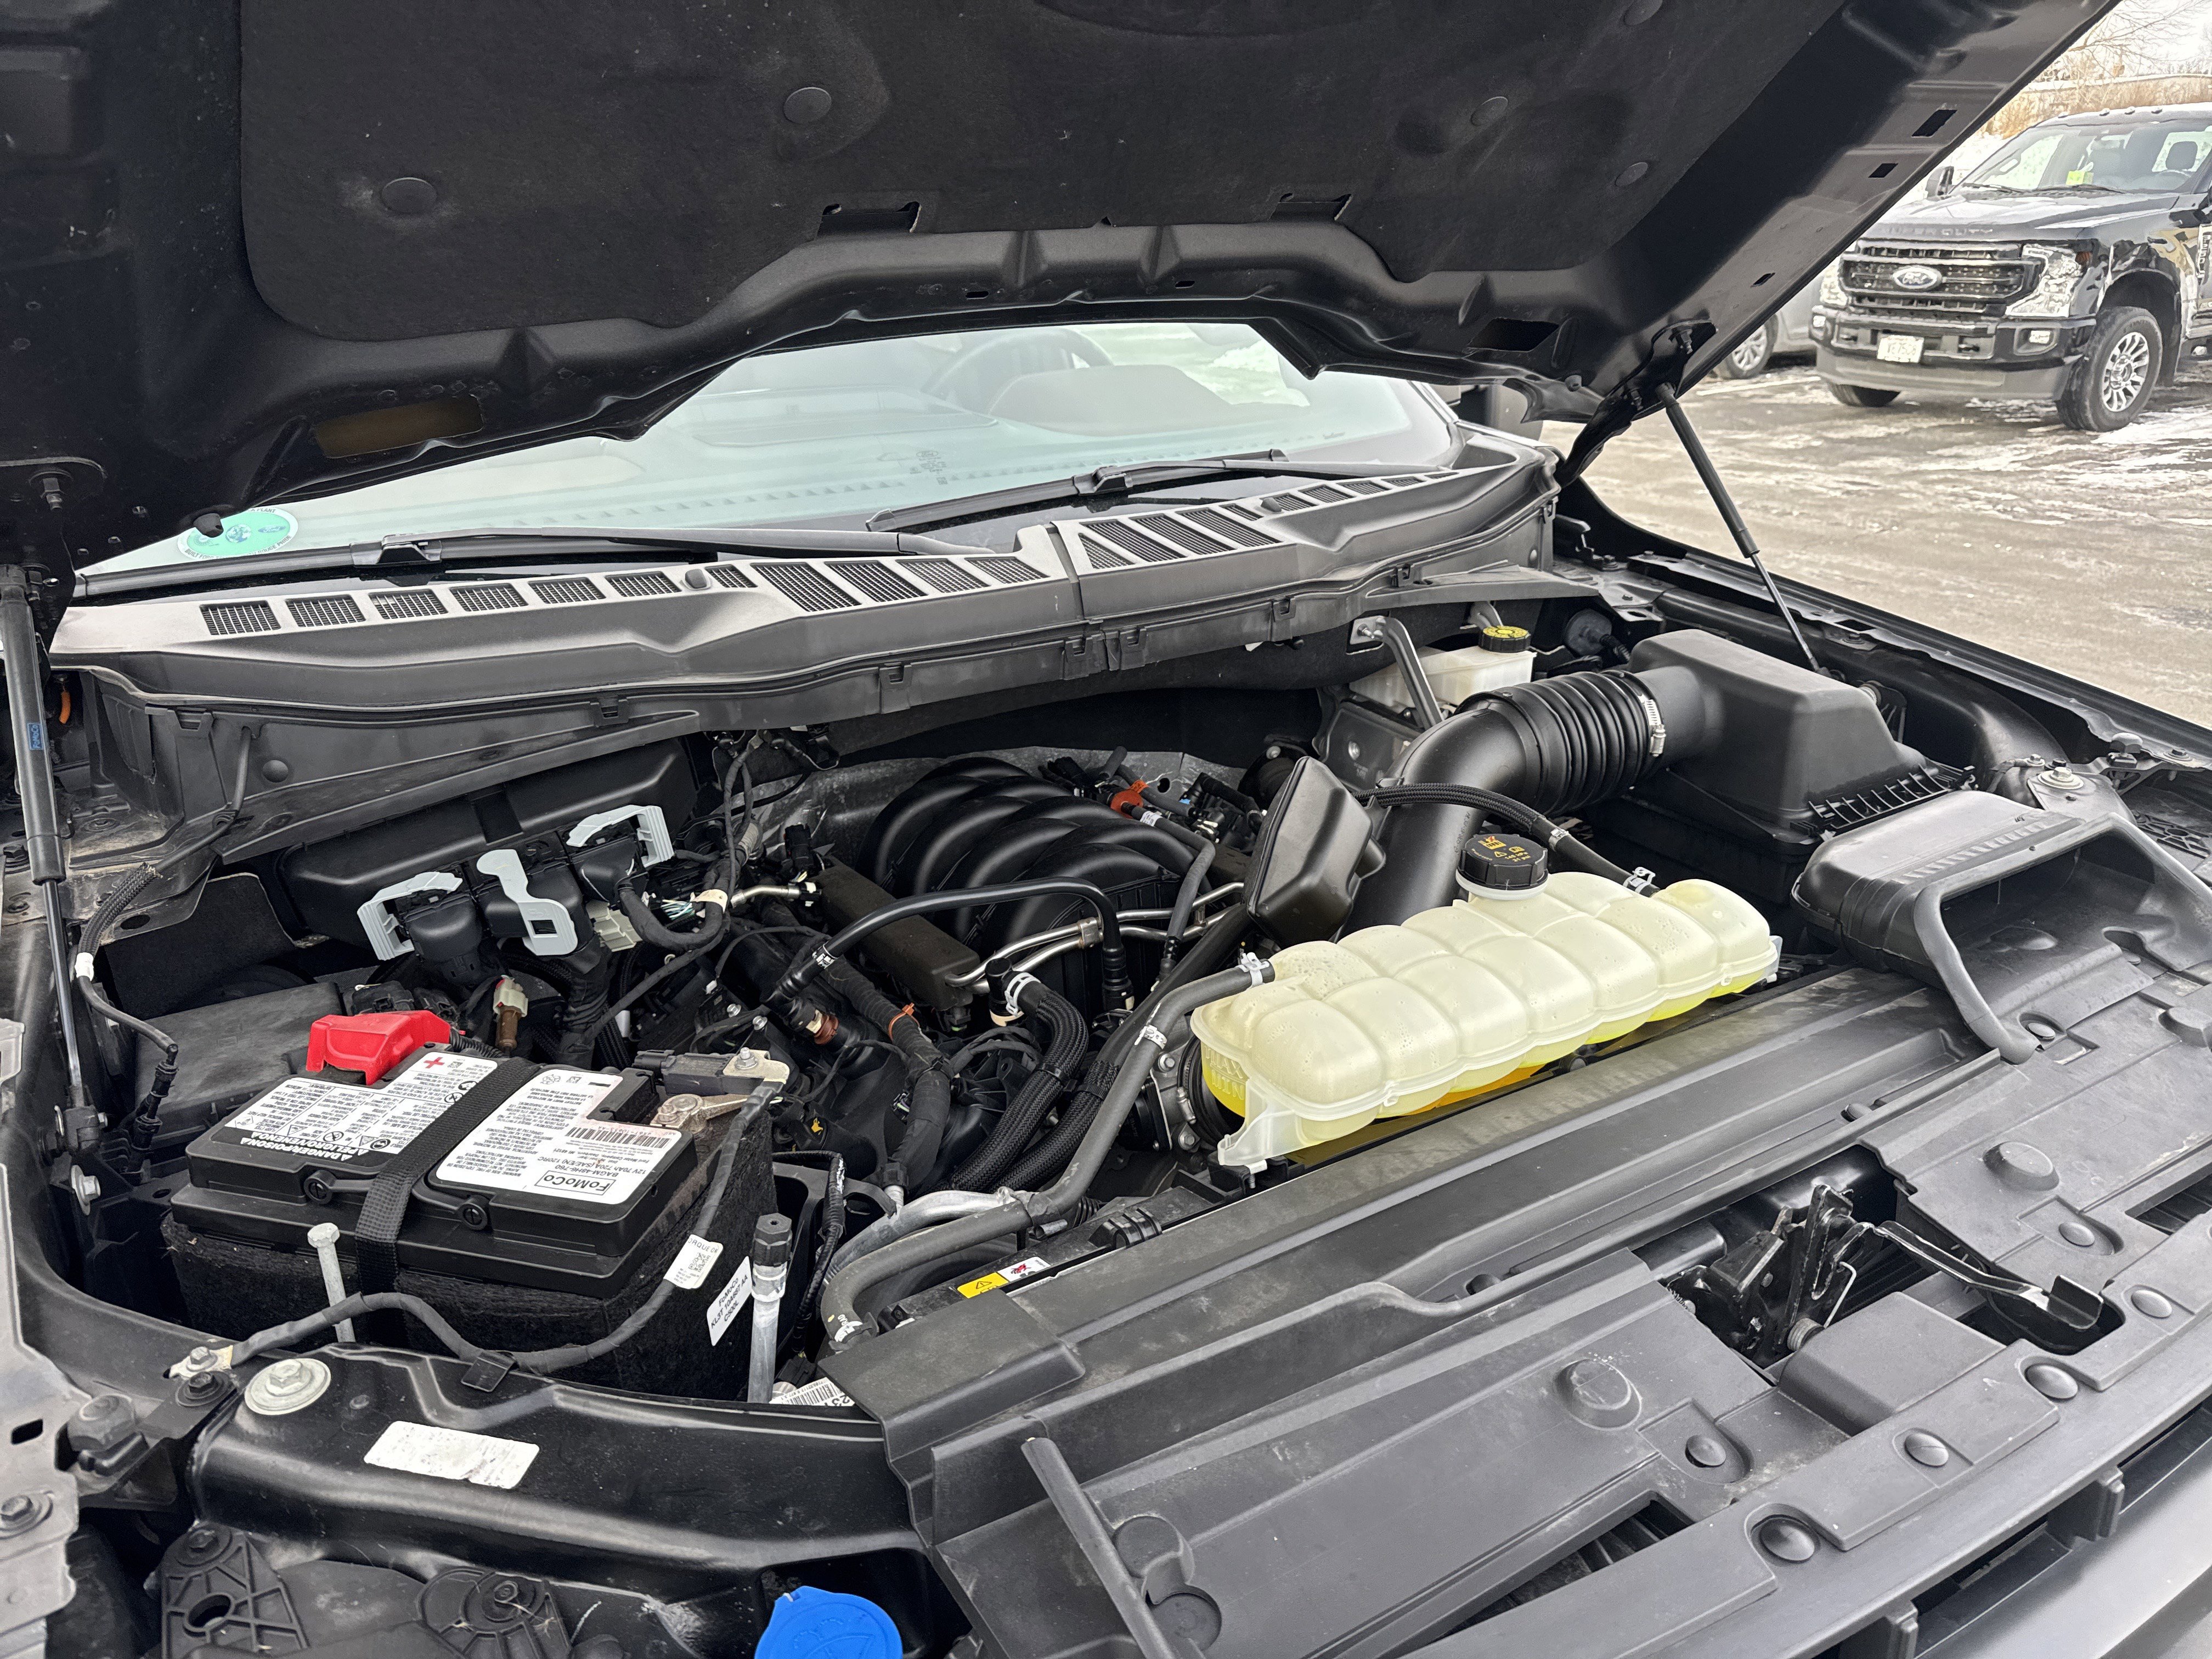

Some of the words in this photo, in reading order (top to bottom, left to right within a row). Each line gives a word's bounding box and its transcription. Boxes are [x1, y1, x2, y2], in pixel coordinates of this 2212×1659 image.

[249, 1139, 340, 1158] DANGER/POISON
[259, 1133, 357, 1153] PELIGRO/VENENO
[544, 1175, 609, 1190] FoMoCo
[688, 1238, 710, 1252] ORQUE
[711, 1308, 723, 1328] KL3T
[741, 1274, 747, 1286] AA
[719, 1278, 738, 1306] FoMoCo
